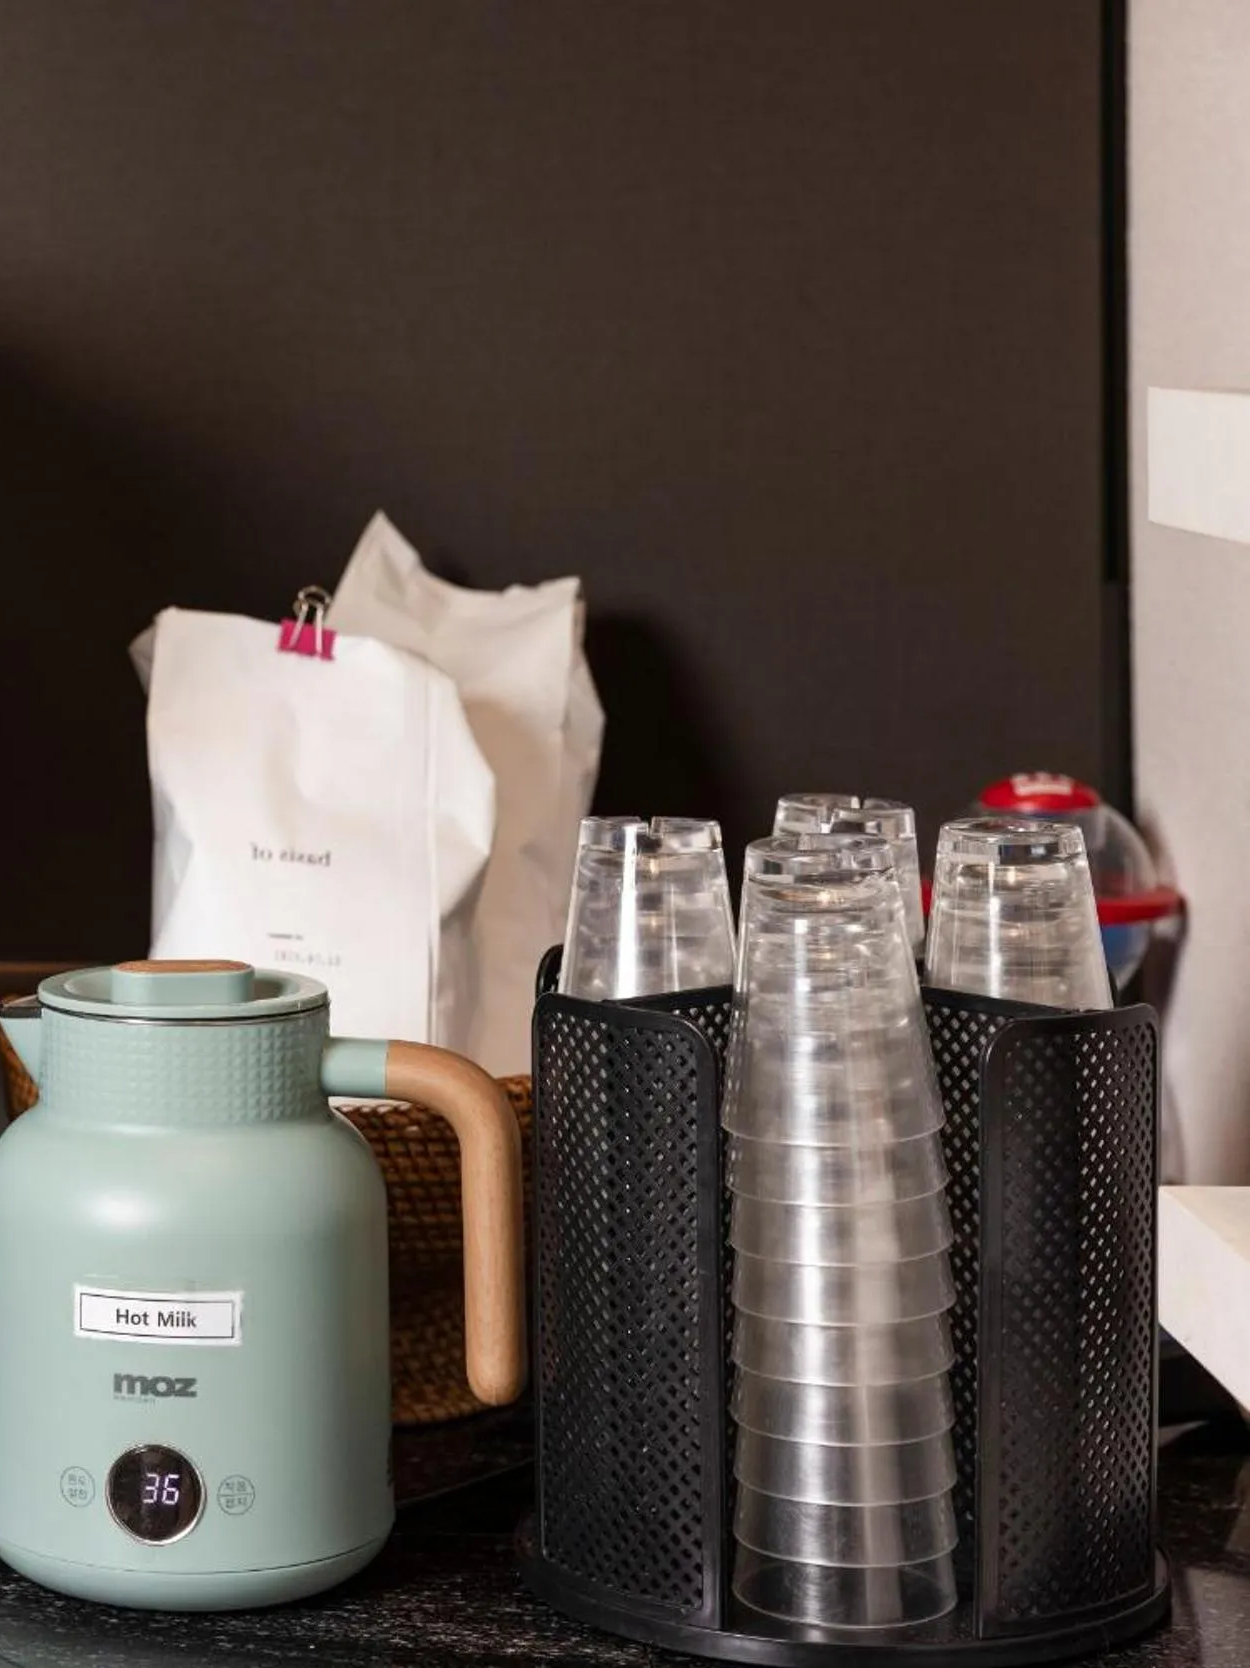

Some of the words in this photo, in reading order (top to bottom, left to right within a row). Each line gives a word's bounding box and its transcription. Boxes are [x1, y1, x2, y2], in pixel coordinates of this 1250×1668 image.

[115, 1307, 150, 1326] Hot
[156, 1310, 198, 1329] Milk
[113, 1372, 198, 1398] moz
[142, 1472, 180, 1505] 36
